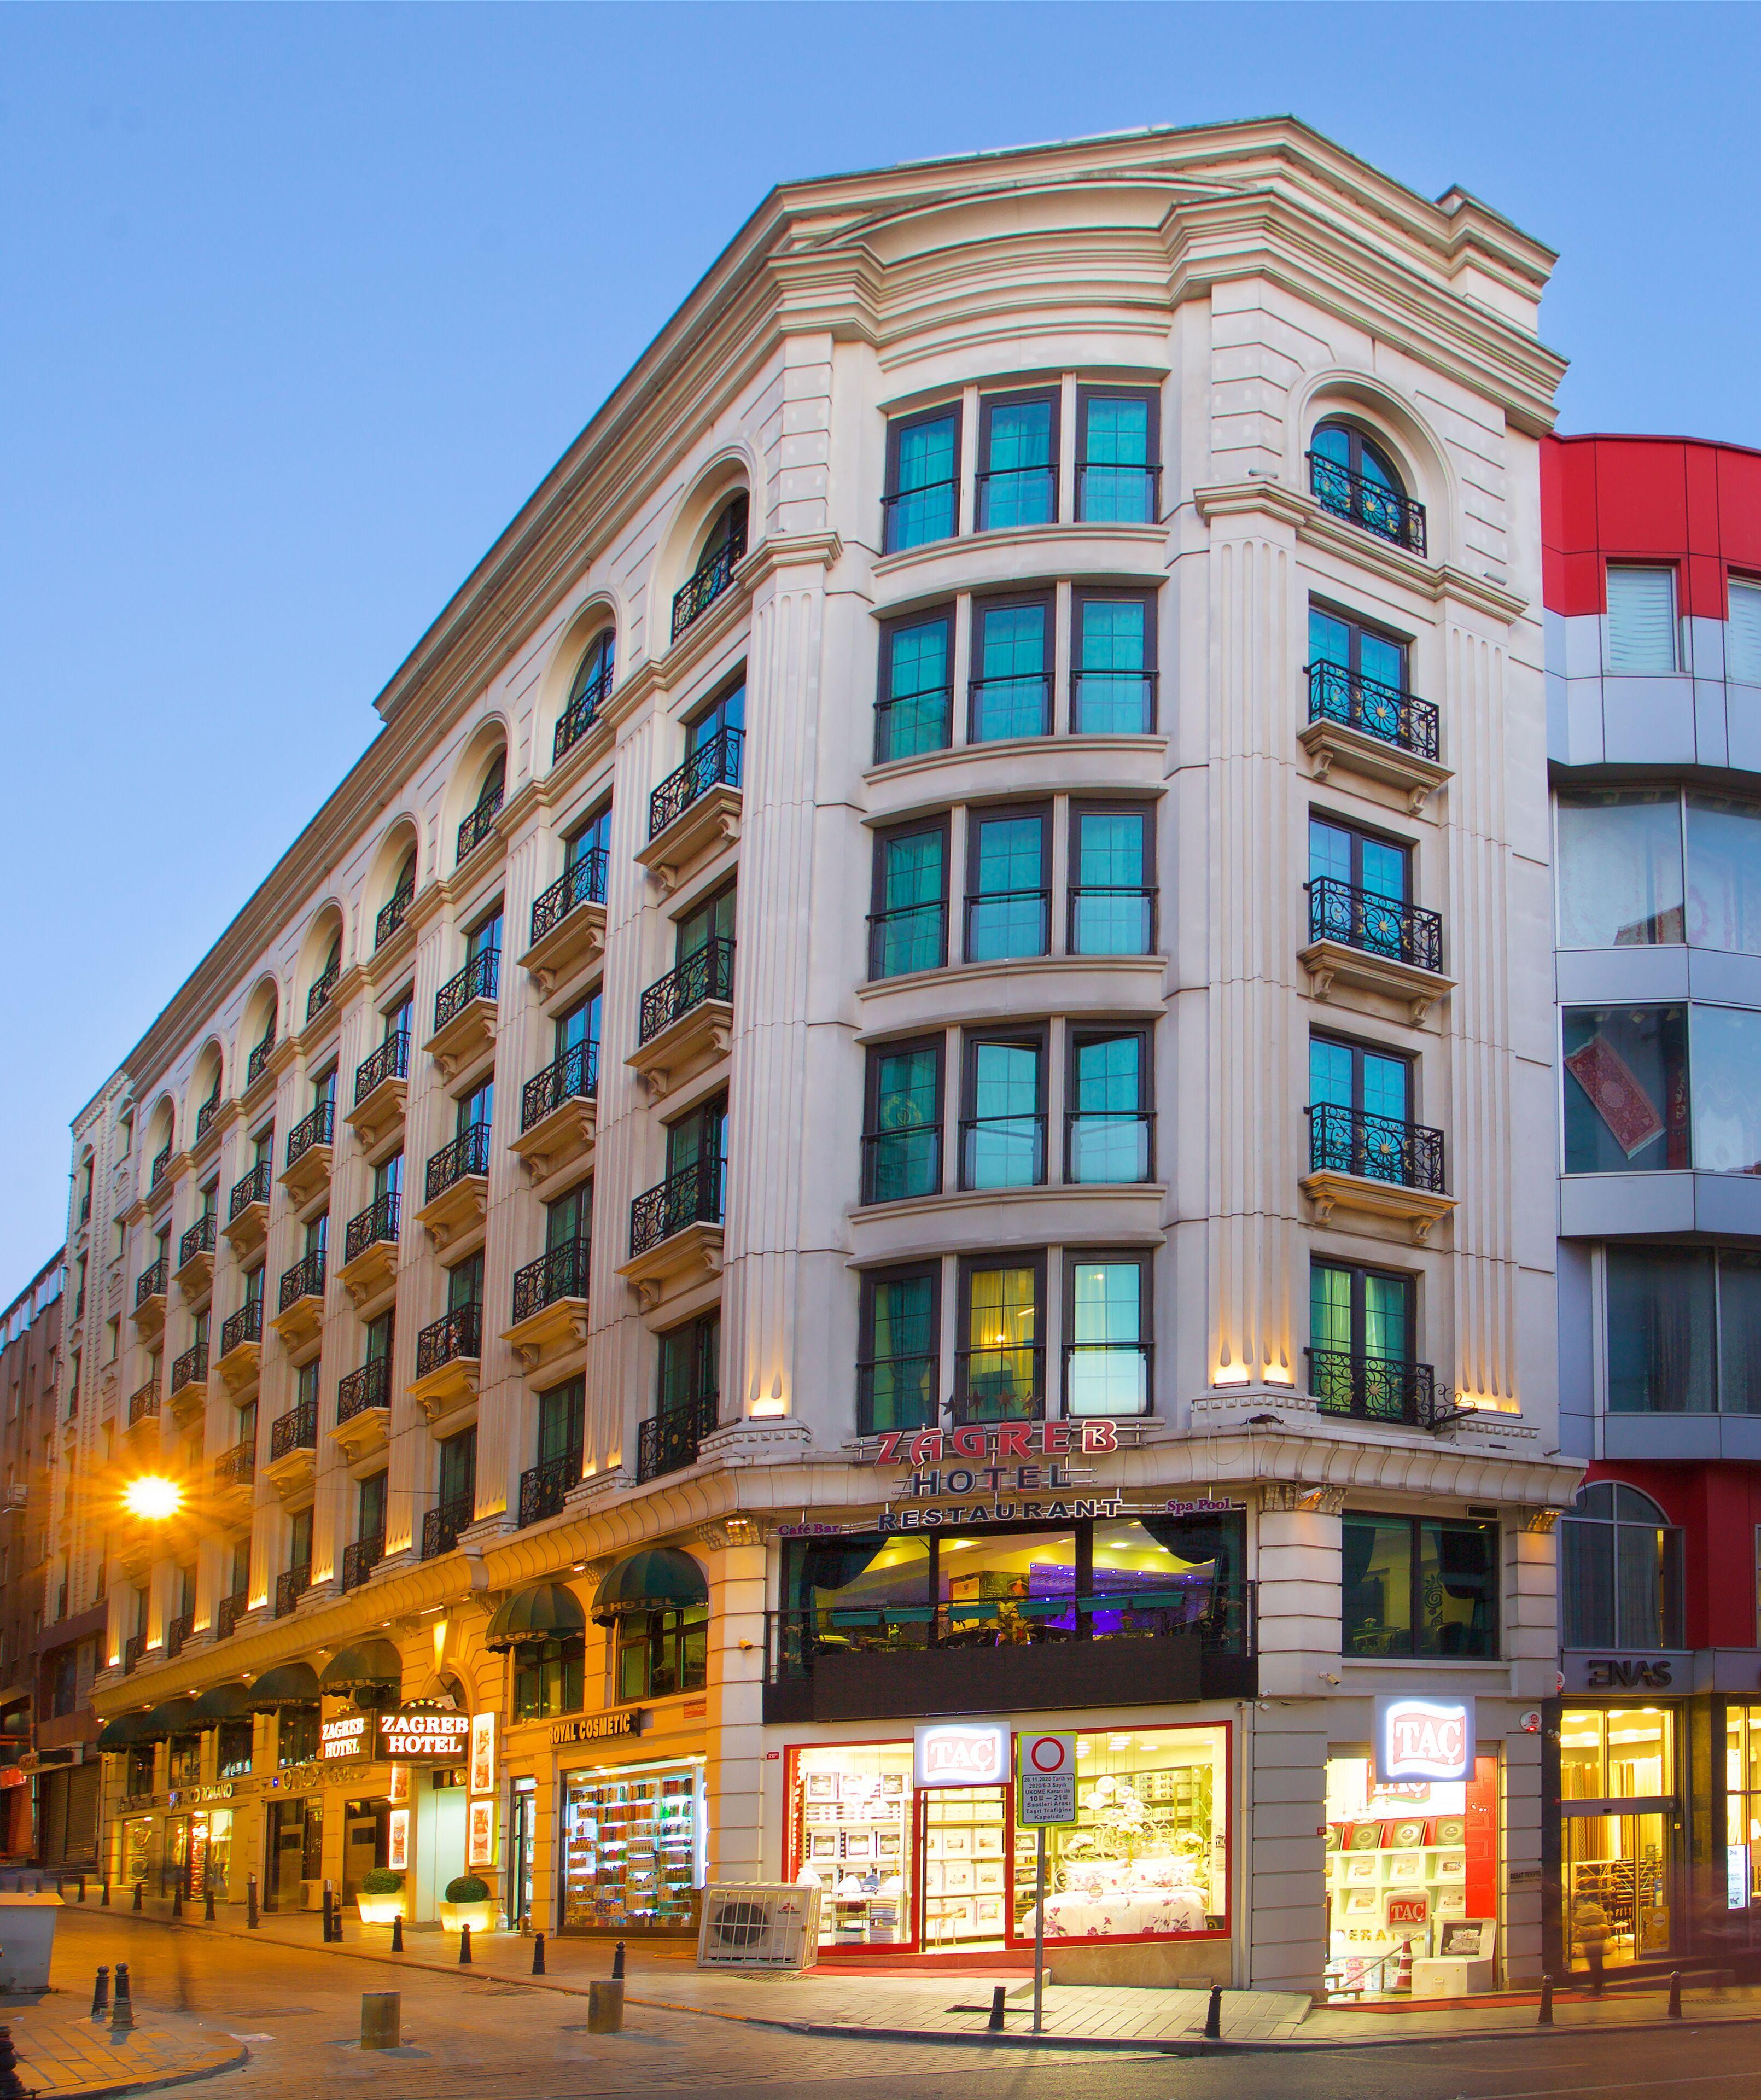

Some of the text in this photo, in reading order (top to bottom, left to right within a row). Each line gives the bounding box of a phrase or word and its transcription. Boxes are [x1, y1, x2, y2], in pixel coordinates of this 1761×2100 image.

[876, 1419, 1118, 1467] ZAGREB
[911, 1462, 1074, 1497] HOTEL
[878, 1498, 1123, 1531] RESTAURANT
[1167, 1498, 1231, 1515] Spa Pool
[778, 1523, 839, 1536] Café Bar
[610, 1597, 676, 1612] HOTEL
[322, 1718, 364, 1740] ZAGREB
[381, 1716, 469, 1734] ZAGREB
[548, 1713, 631, 1745] ROYAL COSMETIC
[324, 1738, 360, 1759] HOTEL
[388, 1735, 462, 1753] HOTEL
[1395, 1720, 1461, 1765] TAÇ
[930, 1740, 993, 1771] TAÇ
